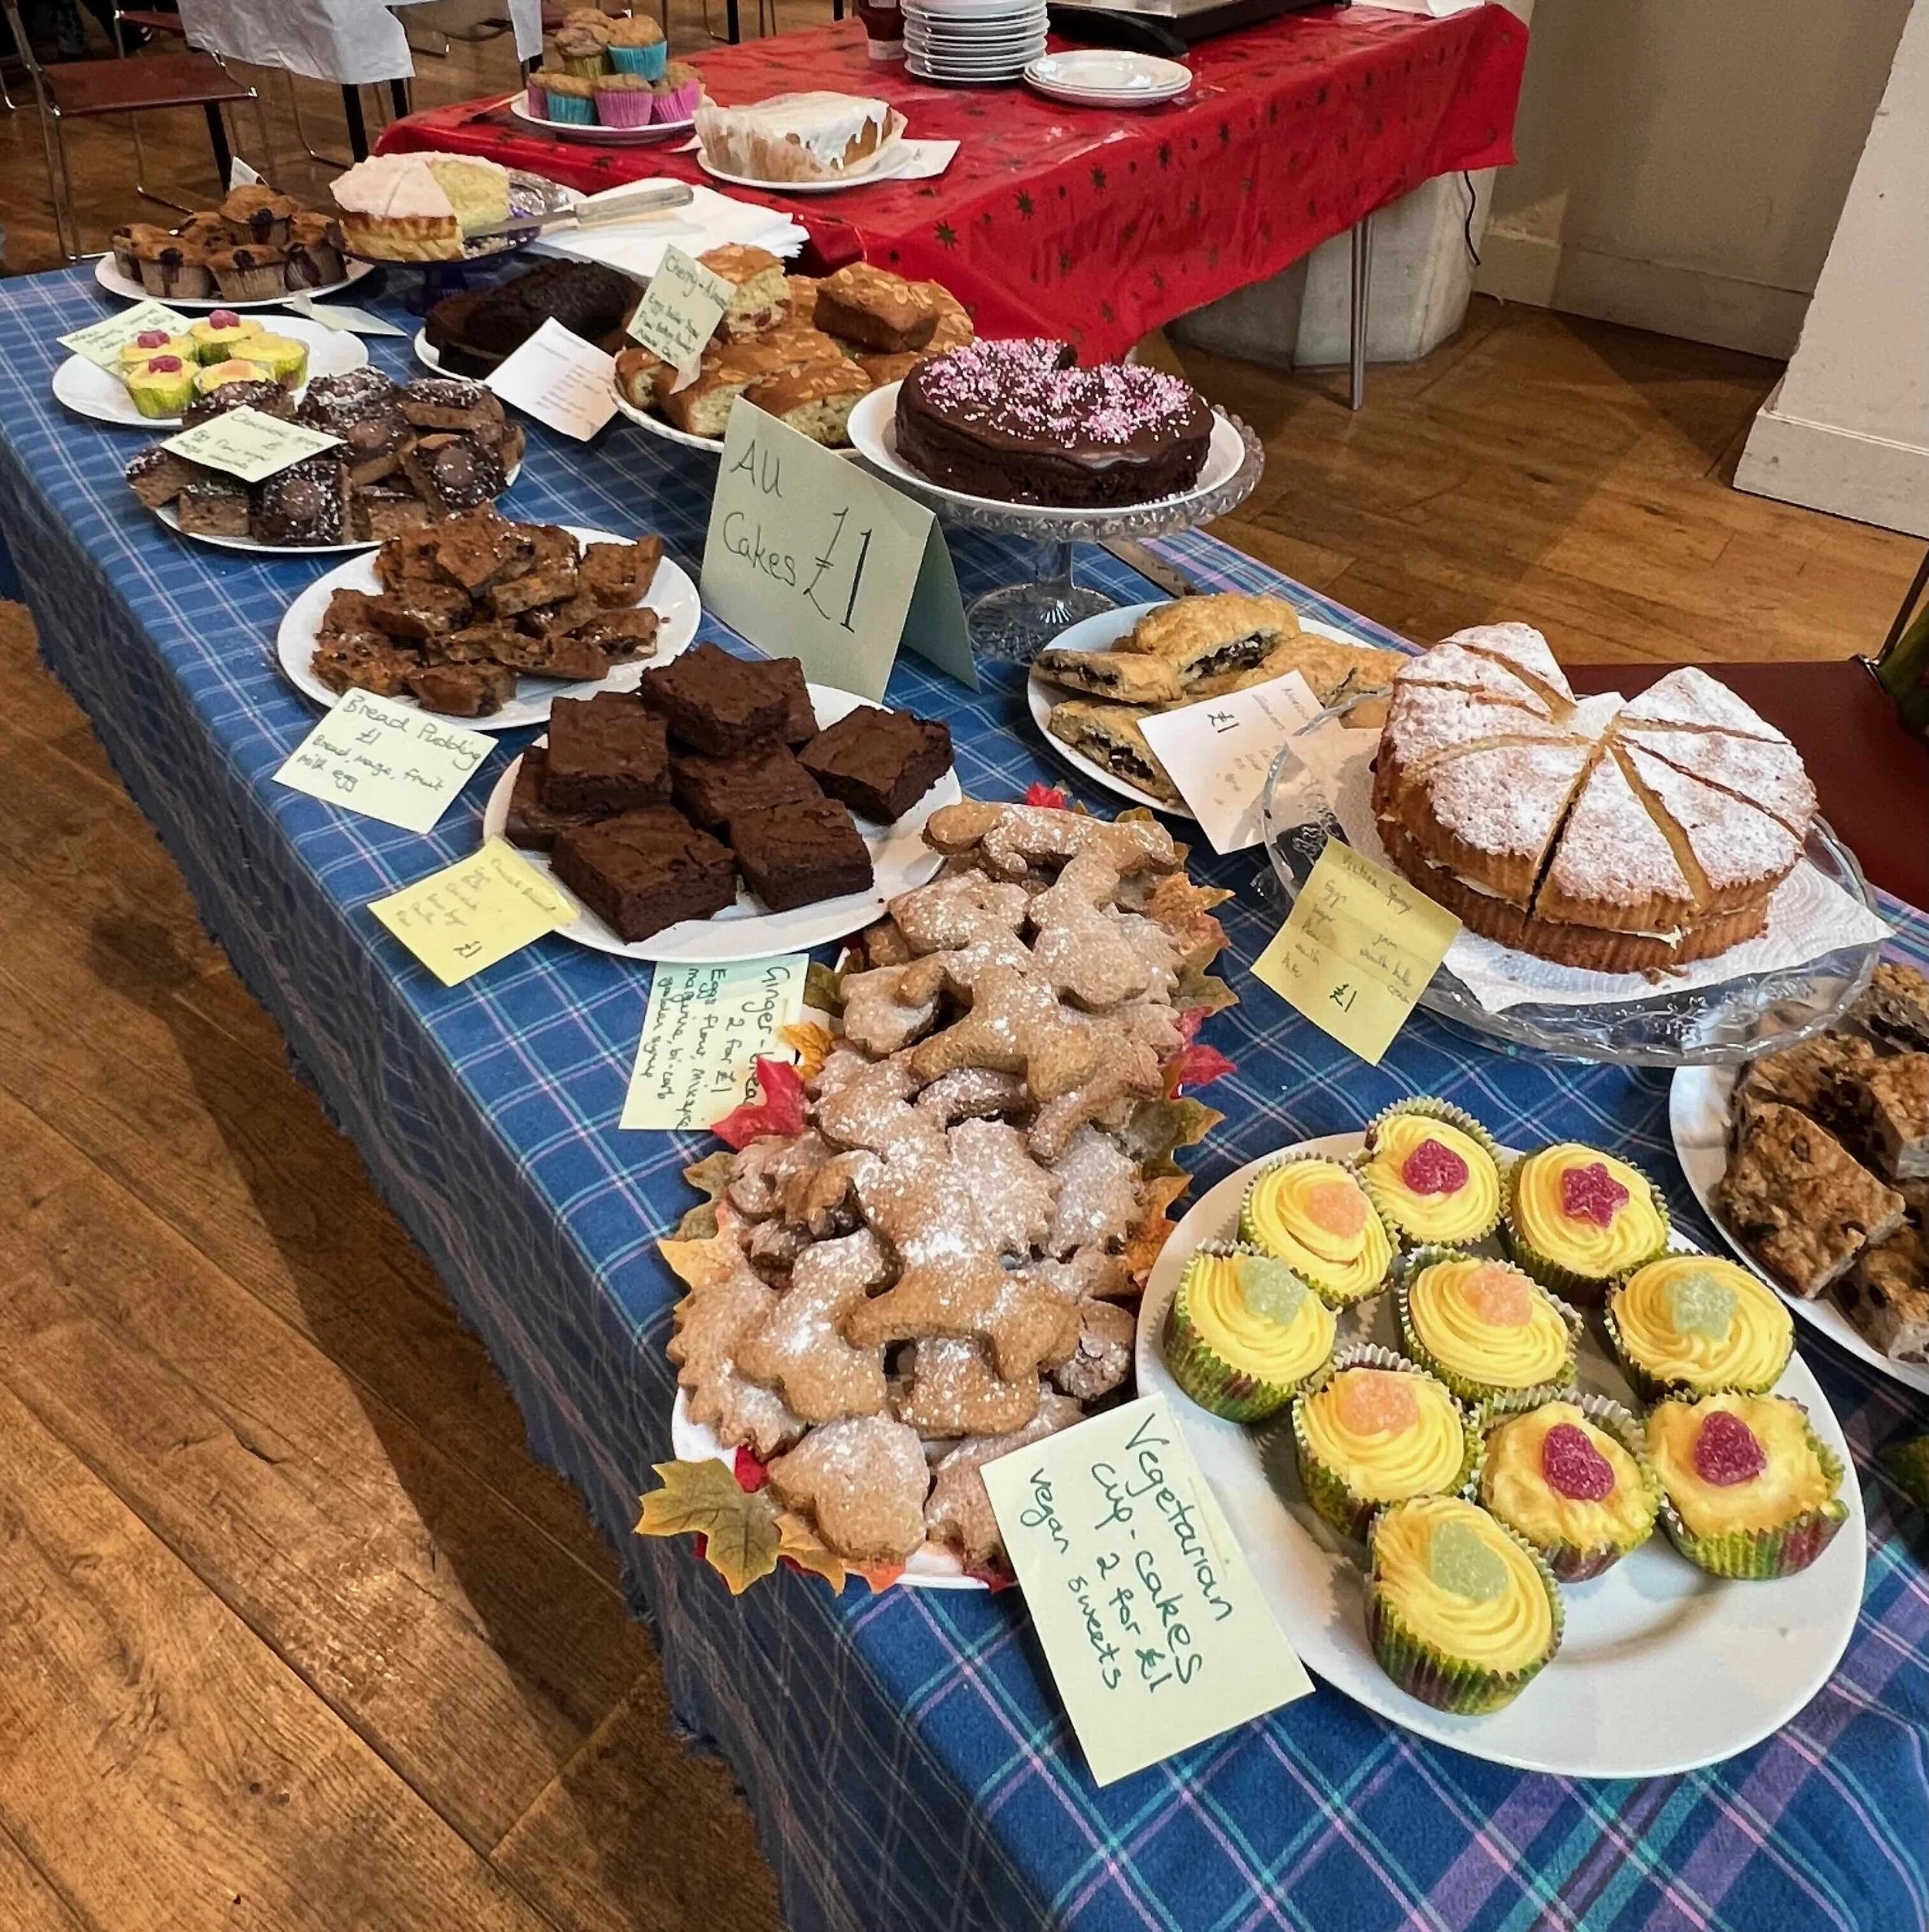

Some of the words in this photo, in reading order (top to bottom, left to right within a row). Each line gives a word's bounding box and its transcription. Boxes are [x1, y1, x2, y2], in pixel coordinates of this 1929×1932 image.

[723, 512, 796, 586] Cakes
[802, 507, 873, 633] £1
[342, 694, 410, 732] Bread
[417, 722, 482, 771] Pudding
[1207, 711, 1240, 734] £1
[355, 728, 382, 745] £1
[452, 940, 482, 958] £1
[1329, 983, 1357, 1013] £1
[726, 1017, 745, 1032] 2
[721, 1039, 743, 1064] for
[711, 1070, 737, 1093] £1
[1124, 1413, 1233, 1620] Vegetarian
[1020, 1468, 1069, 1555] vegan
[1068, 1576, 1122, 1690] sweets
[1096, 1552, 1120, 1582] 2
[1109, 1586, 1140, 1636] for
[1135, 1647, 1174, 1694] £1
